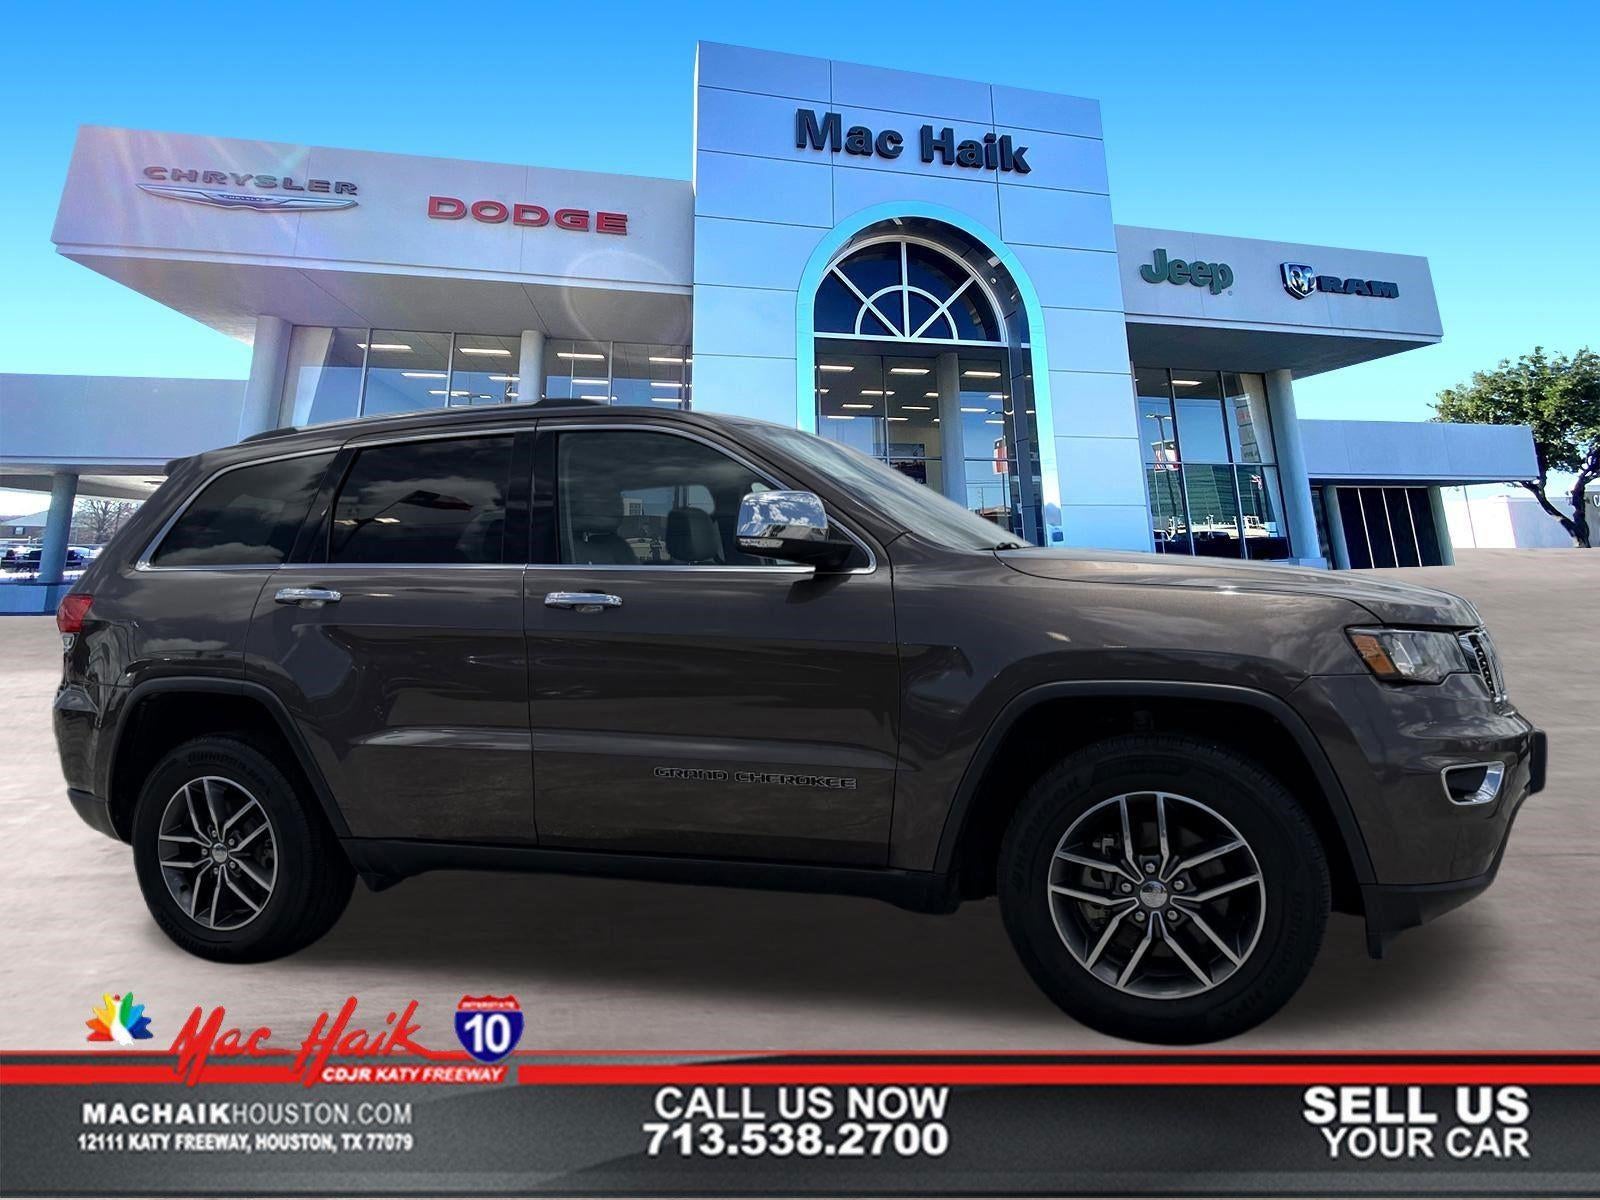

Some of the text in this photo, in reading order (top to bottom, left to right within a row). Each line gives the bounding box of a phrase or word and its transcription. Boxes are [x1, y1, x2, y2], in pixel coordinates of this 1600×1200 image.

[794, 108, 1031, 174] Mac Haik
[143, 166, 359, 196] CHRYSLER
[427, 195, 628, 236] DODGE
[1140, 248, 1234, 296] Jeep
[1316, 275, 1400, 299] RAM
[653, 767, 857, 790] GRAND CHEROKEE
